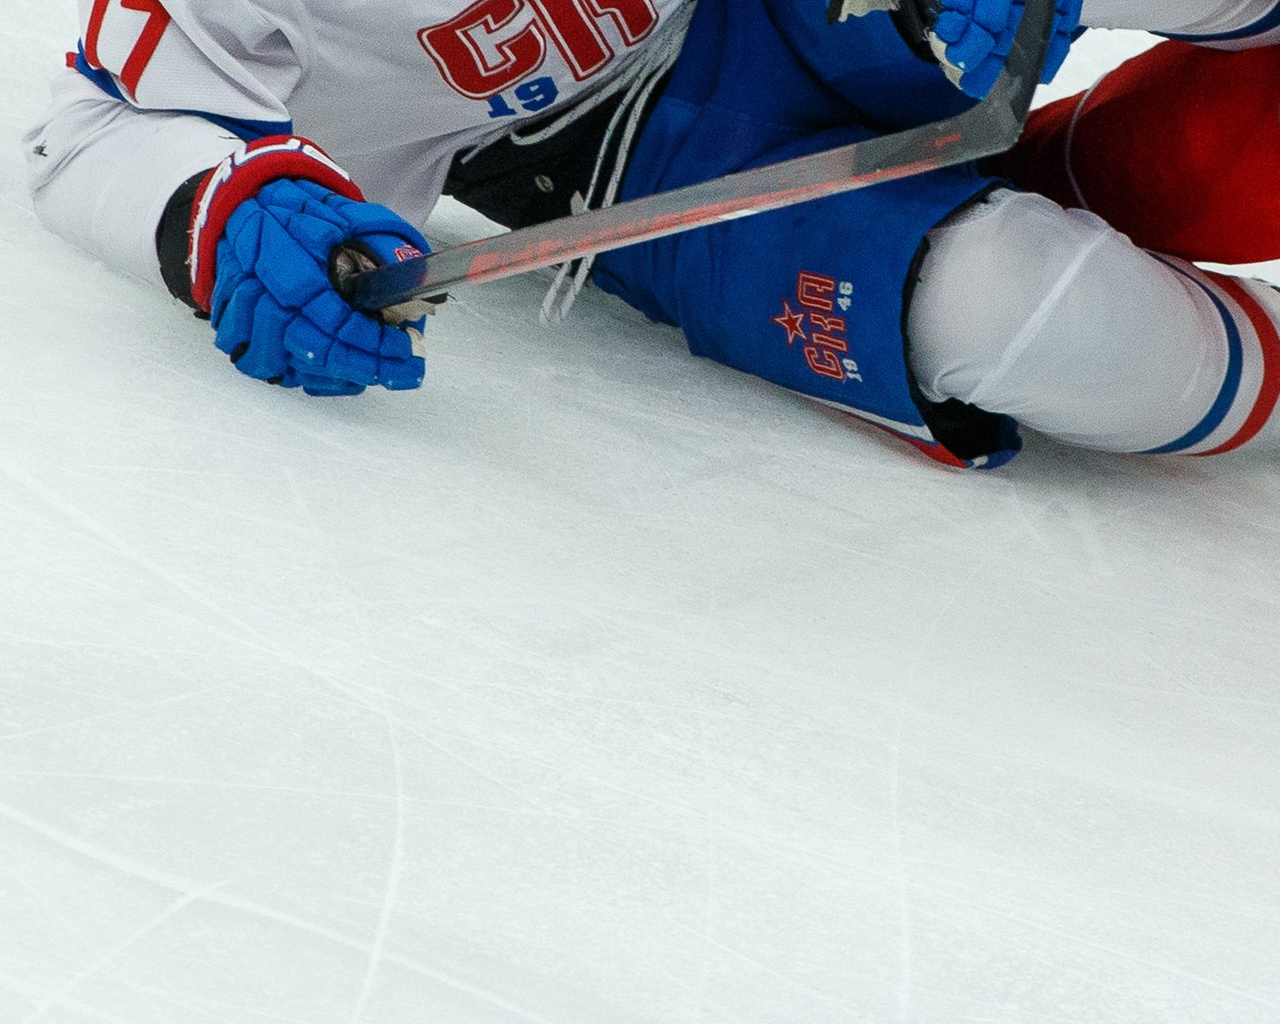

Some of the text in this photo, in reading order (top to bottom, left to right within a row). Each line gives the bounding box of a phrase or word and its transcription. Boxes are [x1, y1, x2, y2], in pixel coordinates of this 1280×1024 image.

[487, 76, 559, 118] 19
[797, 270, 848, 382] СКА
[837, 281, 863, 383] 19 46
